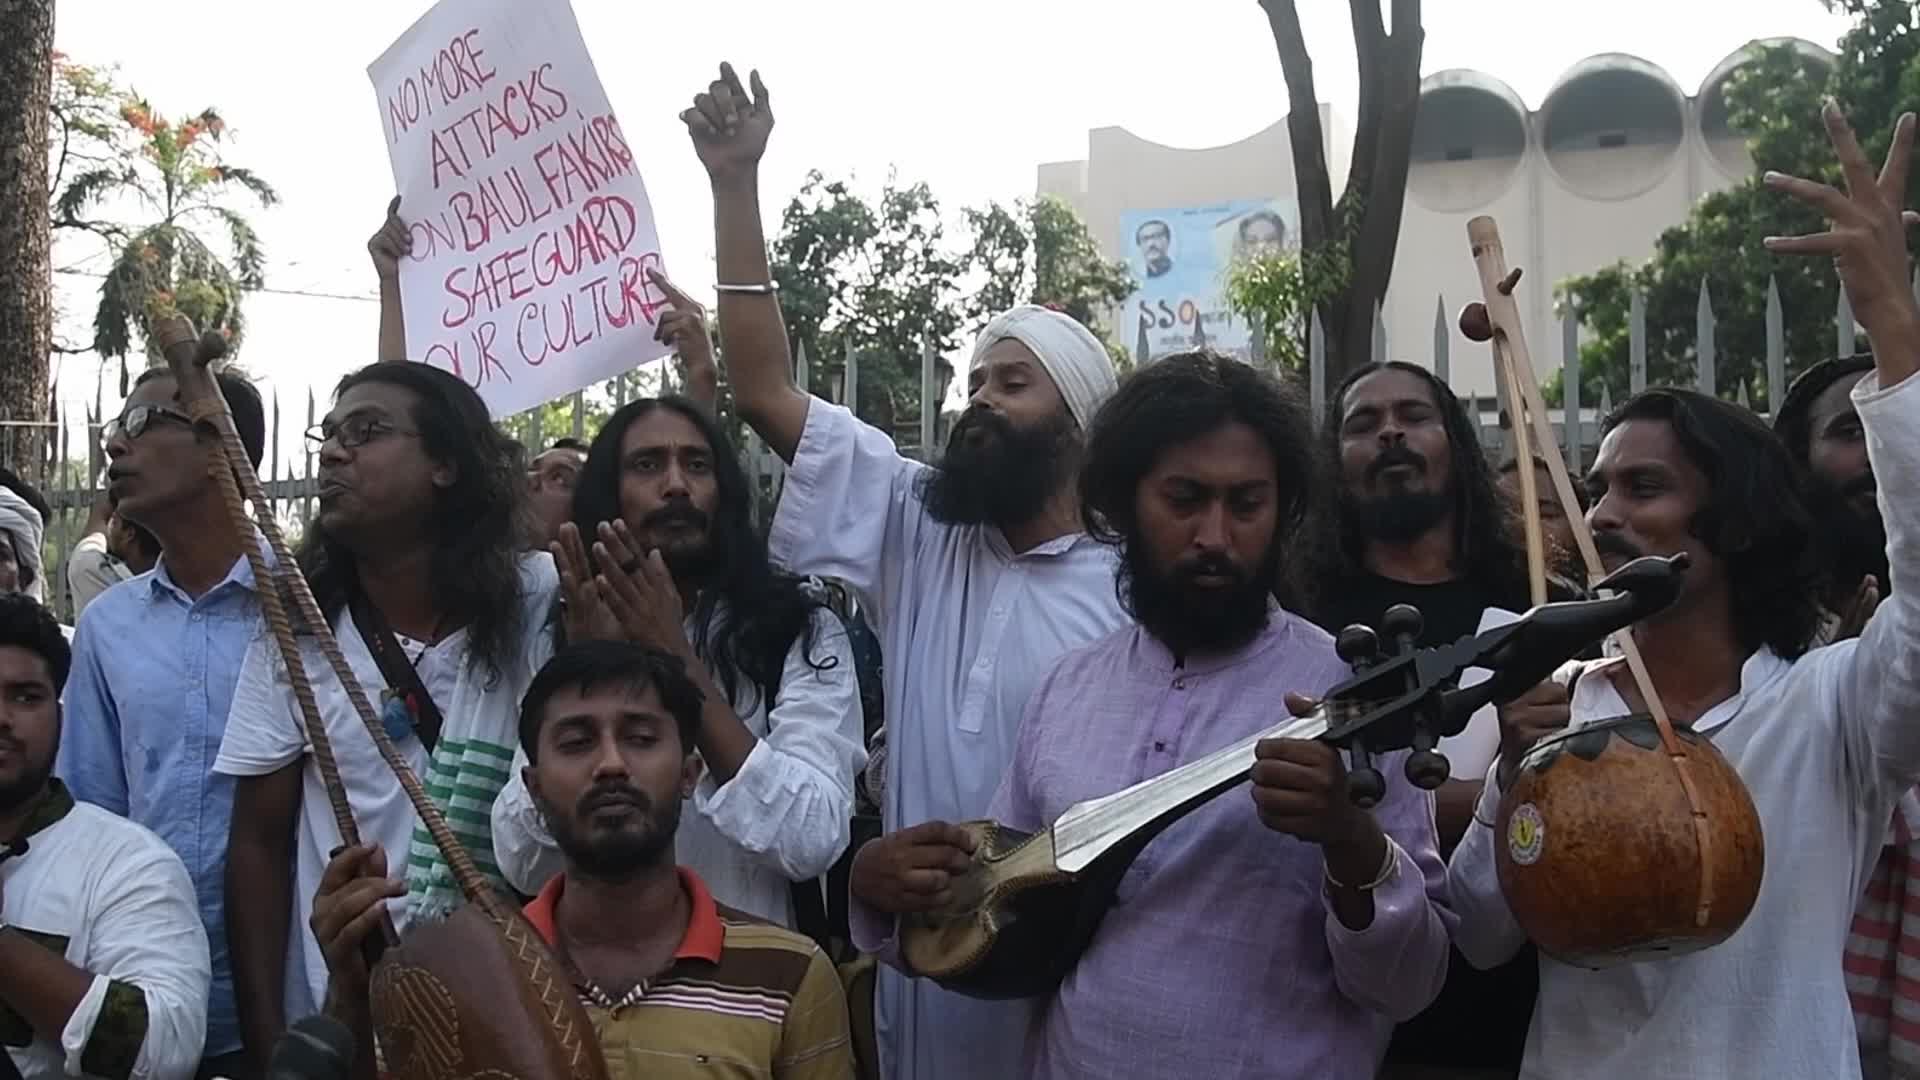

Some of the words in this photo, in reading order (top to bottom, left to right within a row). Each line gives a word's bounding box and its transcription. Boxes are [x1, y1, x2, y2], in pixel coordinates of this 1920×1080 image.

[389, 79, 419, 143] NO
[420, 29, 496, 115] MORE
[430, 63, 568, 189] ATTACKS
[407, 213, 457, 262] ON
[450, 166, 552, 252] BAUL
[442, 196, 636, 328] SAFEGUARD
[517, 252, 668, 366] CULTURE
